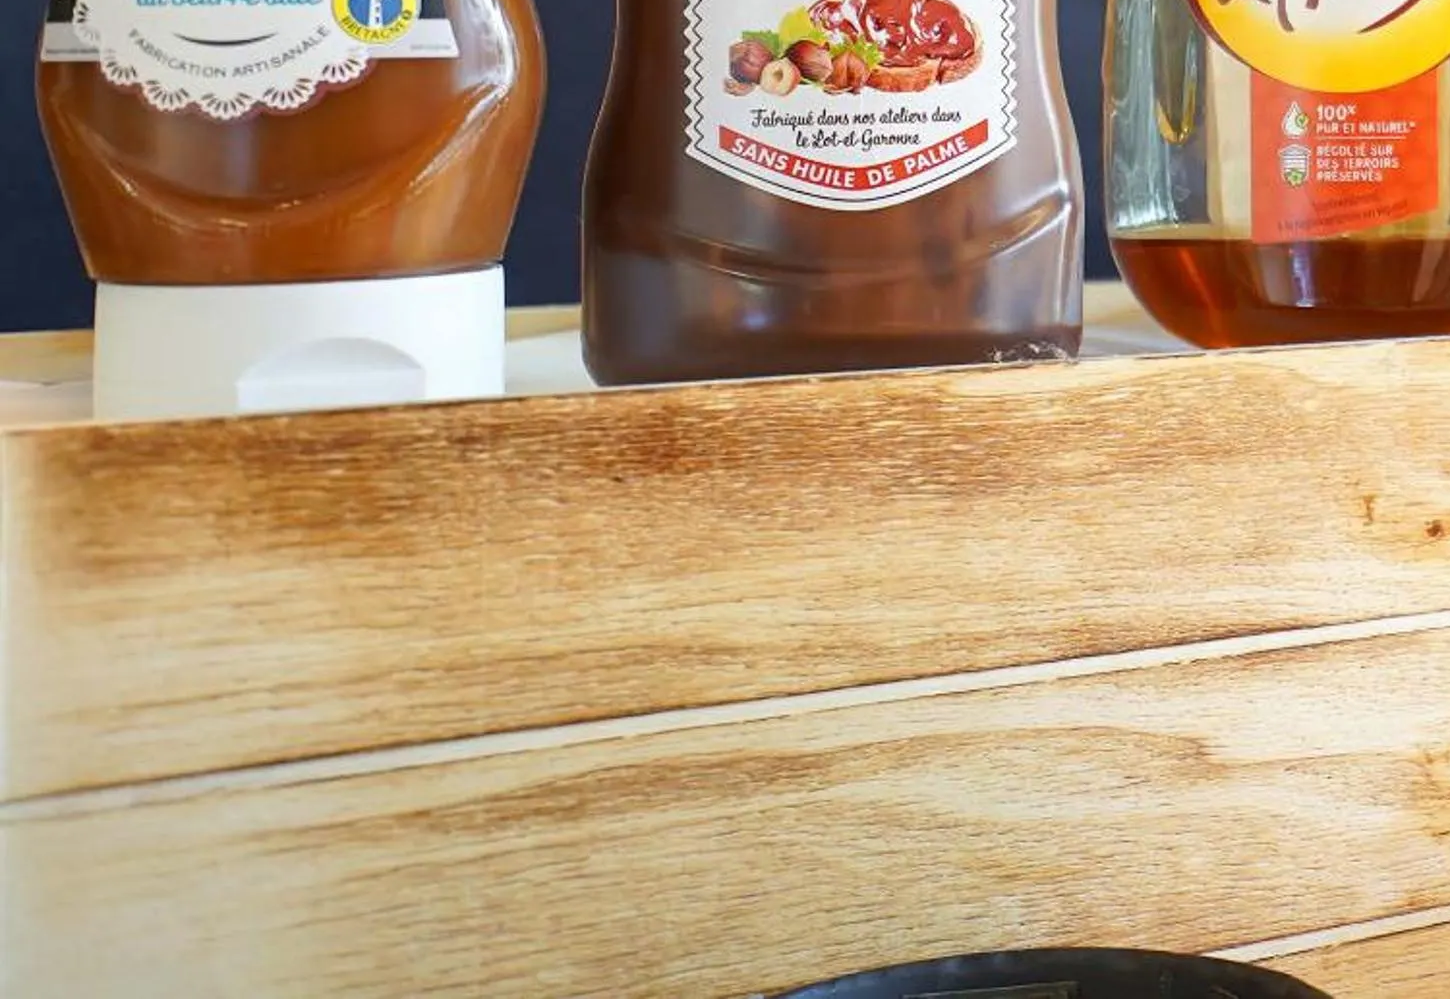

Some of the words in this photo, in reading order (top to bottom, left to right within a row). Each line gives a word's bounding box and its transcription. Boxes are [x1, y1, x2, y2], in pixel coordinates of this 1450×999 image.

[129, 28, 226, 78] FABRICATION
[232, 26, 330, 77] ARTISANALE
[750, 108, 814, 131] Fabriqué
[817, 109, 849, 125] dans
[853, 113, 875, 125] nos
[880, 106, 928, 123] ateliers
[932, 107, 962, 122] dans
[1316, 122, 1339, 134] PUR
[1344, 122, 1355, 134] ET
[796, 131, 808, 148] le
[732, 138, 787, 171] SANS
[793, 162, 855, 187] HUILE
[867, 163, 894, 185] DE
[904, 136, 968, 174] PALME
[1370, 146, 1393, 156] SUR
